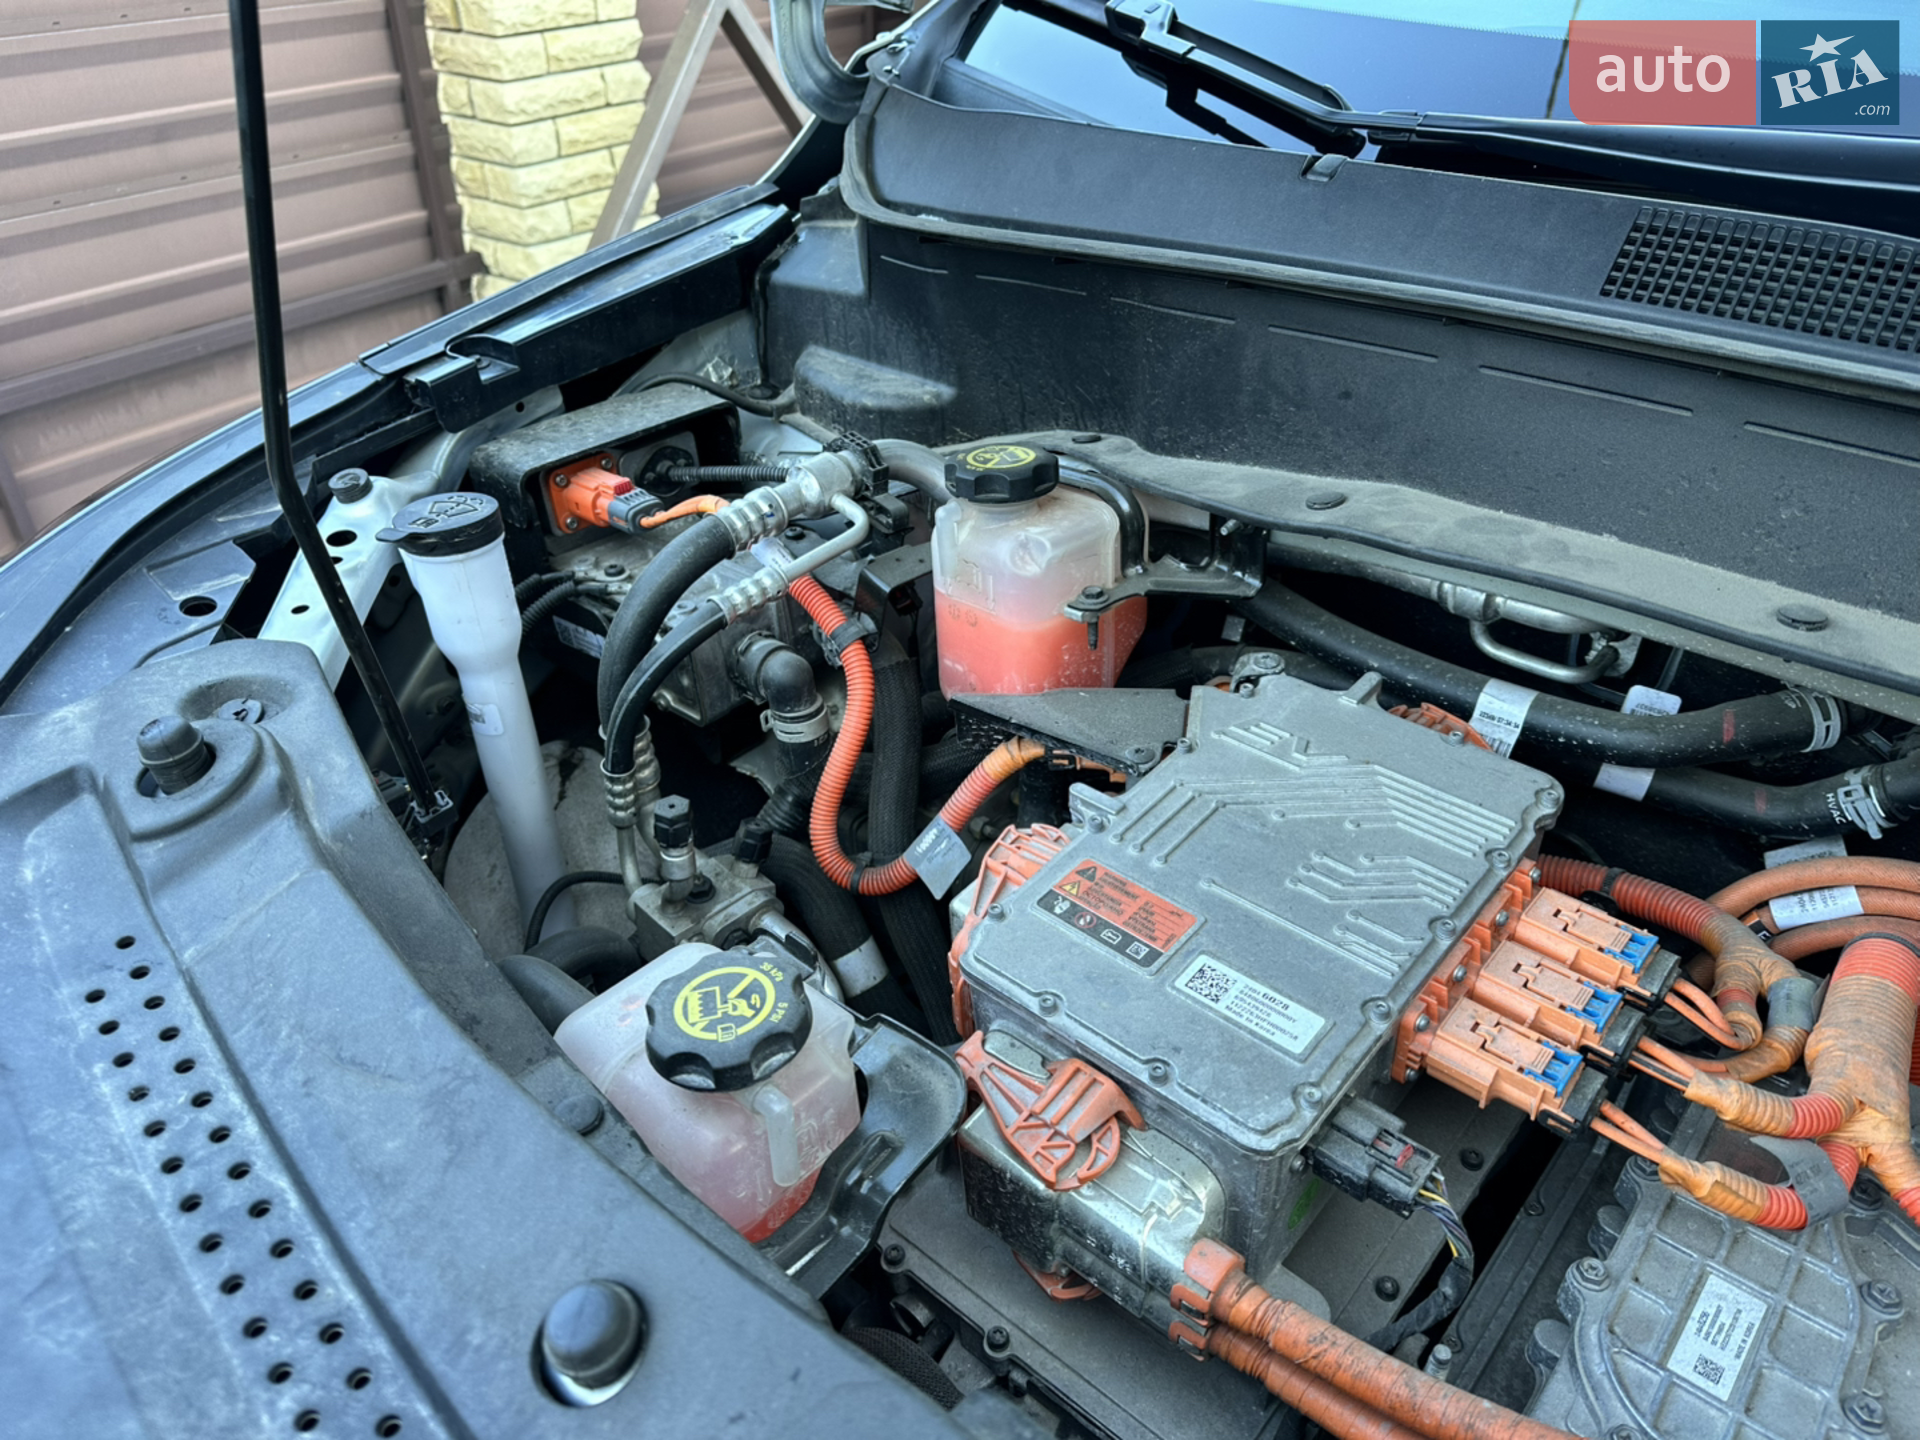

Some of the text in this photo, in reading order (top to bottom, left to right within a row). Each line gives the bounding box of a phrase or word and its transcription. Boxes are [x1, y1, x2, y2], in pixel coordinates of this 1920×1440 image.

[1826, 793, 1847, 825] HVAC
[760, 962, 774, 971] 35
[769, 1009, 785, 1023] PSI
